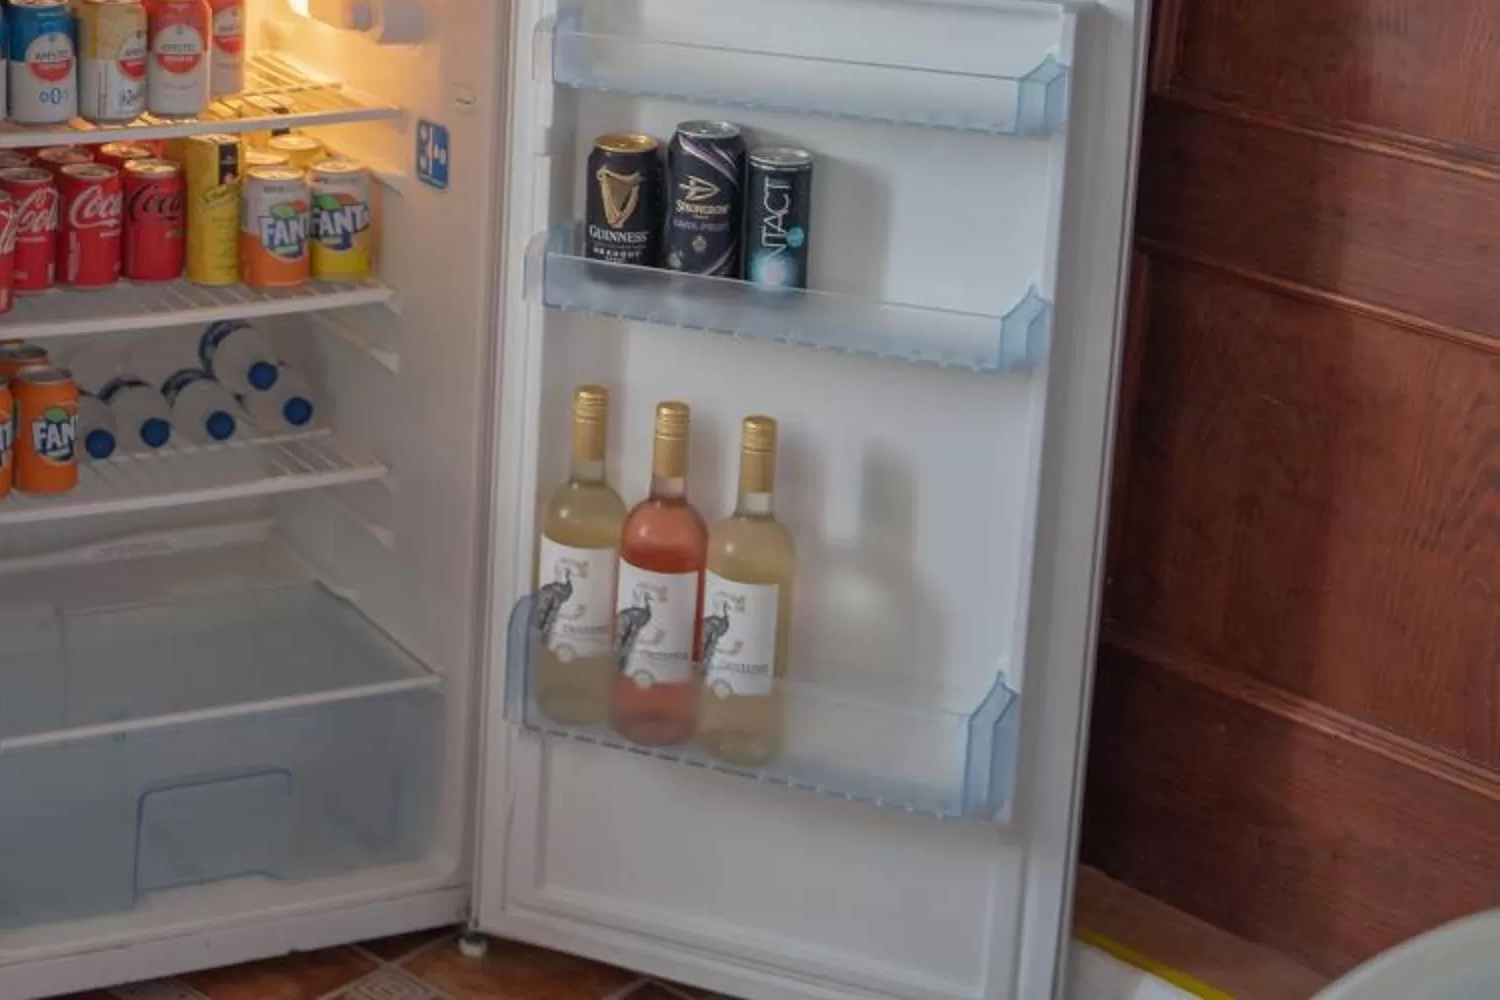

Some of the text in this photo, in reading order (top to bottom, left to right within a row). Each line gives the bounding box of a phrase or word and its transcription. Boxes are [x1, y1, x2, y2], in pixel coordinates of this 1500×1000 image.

[259, 215, 309, 249] FAN
[311, 203, 370, 240] FANT
[588, 224, 649, 243] GUINNESS
